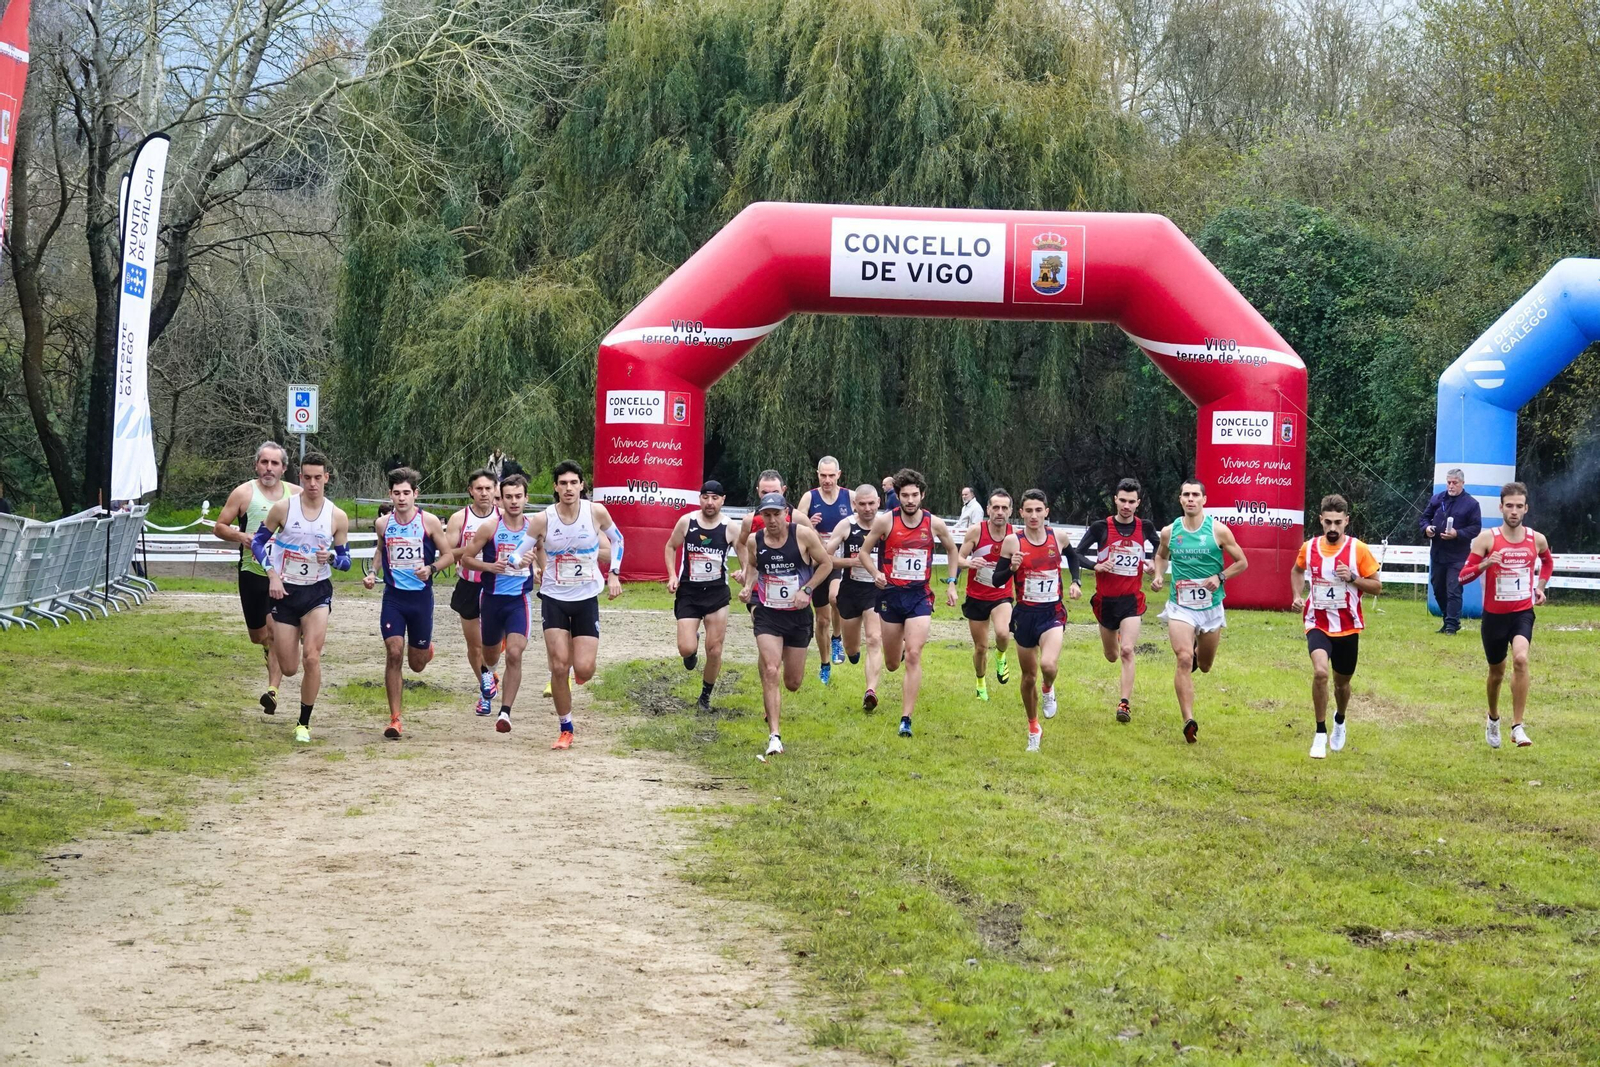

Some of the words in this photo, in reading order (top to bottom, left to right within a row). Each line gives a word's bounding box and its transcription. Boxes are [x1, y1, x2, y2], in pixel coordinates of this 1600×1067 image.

[140, 168, 155, 236] GALICIA
[129, 199, 141, 257] XUNTA
[138, 240, 146, 261] DE
[844, 233, 991, 257] CONCELLO
[861, 260, 896, 282] DE
[907, 262, 973, 284] VIGO
[1494, 294, 1546, 344] DEPORTE
[671, 320, 707, 335] VIGO,
[1500, 308, 1548, 353] GALEGO
[642, 334, 680, 345] terreo
[684, 333, 700, 346] de
[704, 336, 733, 349] xogo
[1204, 338, 1240, 354] VIGO,
[125, 332, 134, 396] GALEGO
[1176, 350, 1213, 363] terreo
[1218, 352, 1234, 364] de
[1238, 354, 1268, 368] xogo
[610, 397, 660, 406] CONCELLO
[614, 408, 624, 416] DE
[630, 408, 653, 416] VIGO
[1216, 418, 1268, 427] CONCELLO
[1220, 428, 1233, 437] DE
[1237, 428, 1262, 438] VIGO
[612, 436, 649, 449] Vivimos
[652, 438, 682, 450] nunha
[608, 452, 640, 464] cidade
[644, 452, 683, 466] fermosa
[1220, 456, 1260, 469] Vivimos
[1264, 458, 1291, 470] nunha
[1218, 472, 1251, 484] cidade
[1255, 472, 1292, 486] fermosa
[626, 479, 662, 496] VIGO,
[603, 494, 636, 505] terreo
[640, 494, 656, 505] de
[660, 496, 686, 510] xogo
[1235, 500, 1271, 516] VIGO,
[1249, 514, 1264, 526] de
[1268, 517, 1293, 530] xogo
[397, 547, 422, 559] 231
[687, 543, 724, 556] Biocouto
[705, 562, 712, 572] 9
[905, 559, 921, 570] 16
[1116, 555, 1138, 567] 232
[300, 564, 308, 576] 3
[575, 565, 582, 576] 2
[1038, 580, 1054, 592] 17
[1515, 578, 1520, 590] 1
[780, 586, 788, 598] 6
[1190, 588, 1206, 600] 19
[1326, 587, 1335, 599] 4
